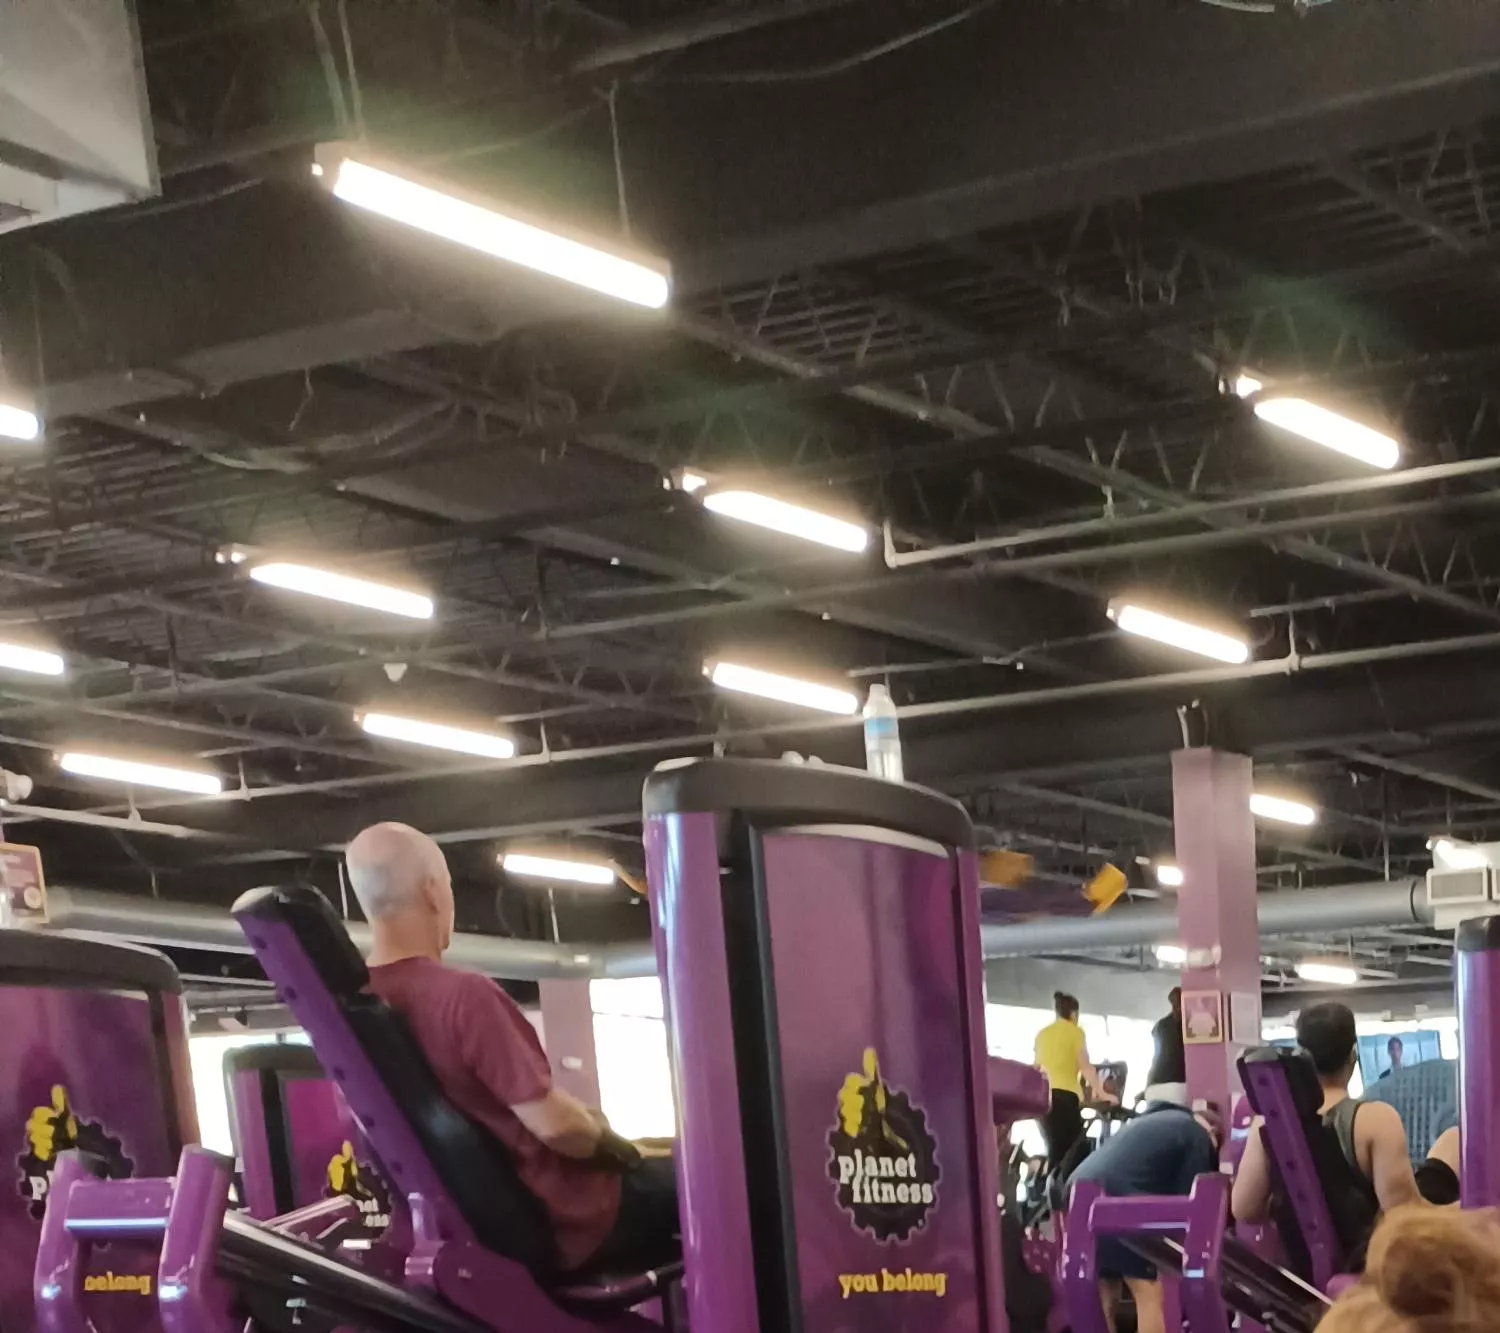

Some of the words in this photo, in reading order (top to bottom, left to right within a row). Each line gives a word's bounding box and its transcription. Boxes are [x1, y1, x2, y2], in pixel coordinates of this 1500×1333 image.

[838, 1149, 916, 1184] planet
[853, 1177, 933, 1204] fitness
[838, 1274, 878, 1299] you
[882, 1267, 946, 1297] belong
